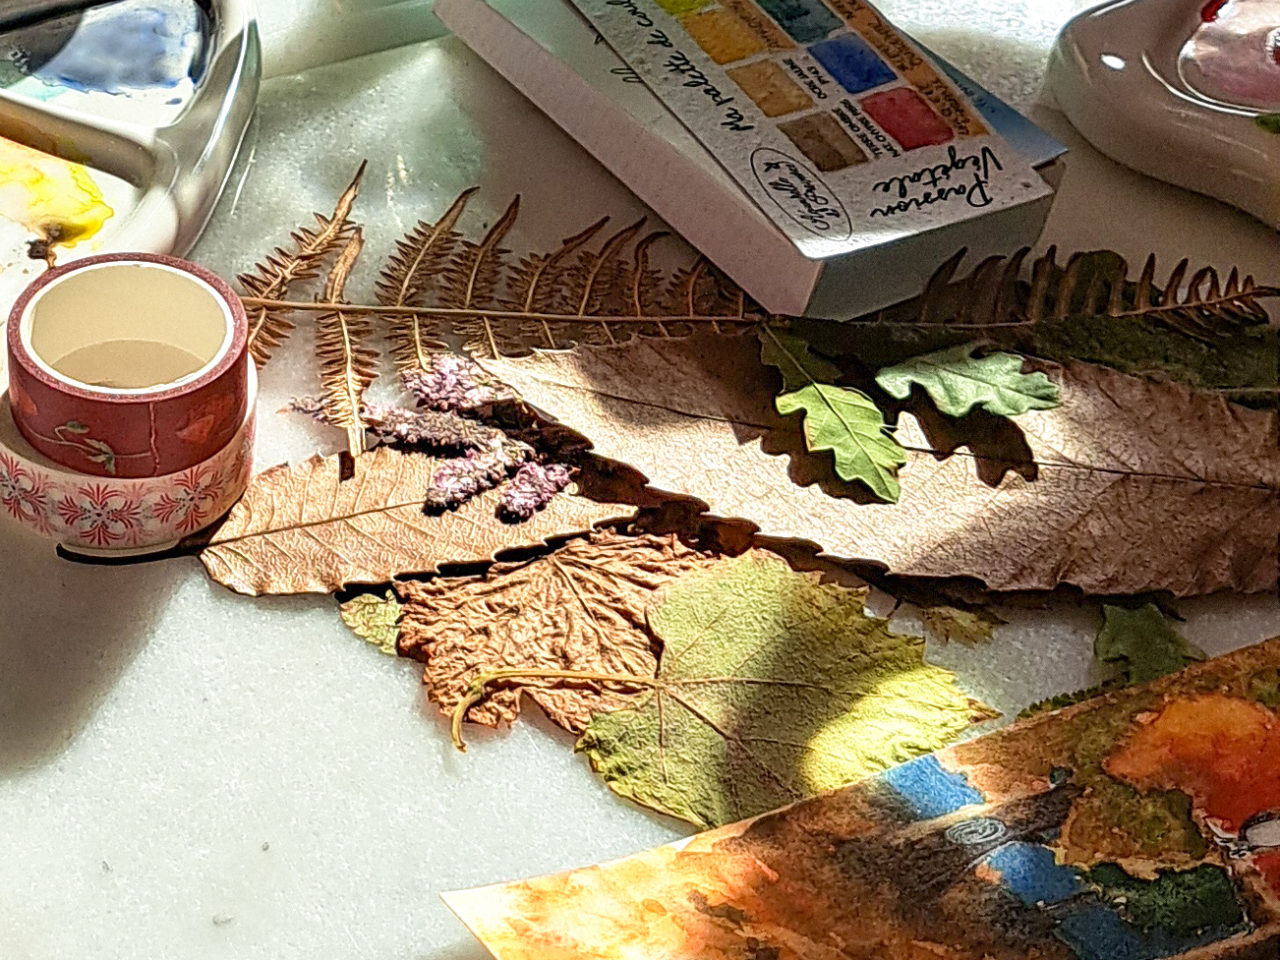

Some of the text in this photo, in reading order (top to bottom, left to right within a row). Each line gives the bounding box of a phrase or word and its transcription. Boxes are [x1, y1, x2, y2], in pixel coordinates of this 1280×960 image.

[647, 29, 674, 47] de
[663, 50, 735, 107] palette
[720, 107, 755, 131] Ma
[872, 145, 1003, 197] Végétale
[870, 174, 993, 217] Passion
